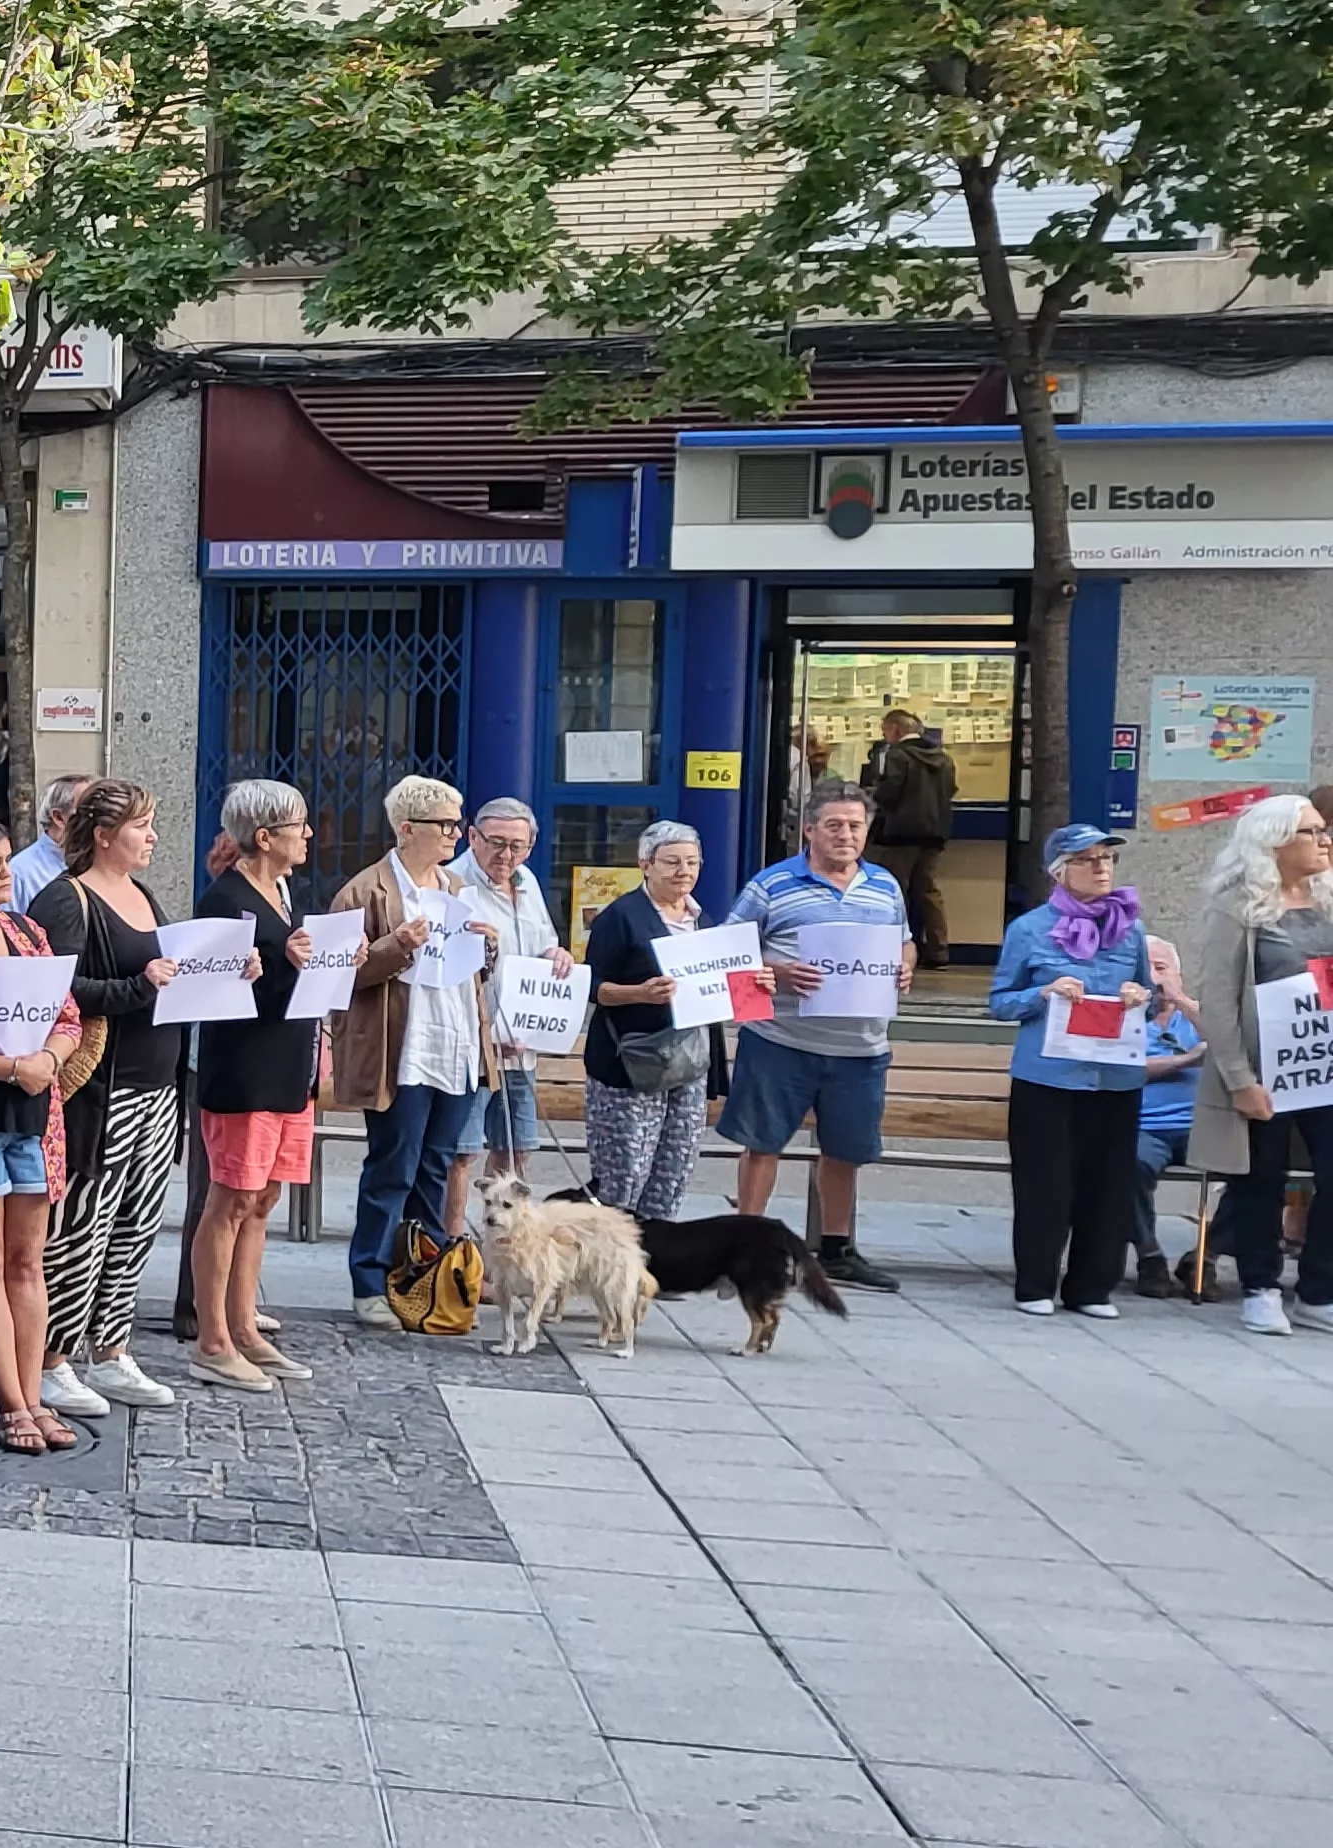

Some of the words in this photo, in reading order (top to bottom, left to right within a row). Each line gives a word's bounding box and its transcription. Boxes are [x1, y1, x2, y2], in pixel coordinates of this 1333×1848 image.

[901, 452, 1024, 478] Loterías
[899, 486, 1033, 518] Apuestas
[1063, 484, 1097, 510] el
[1109, 483, 1215, 509] Estado
[223, 544, 336, 567] LOTERIA
[361, 543, 377, 566] Y
[402, 542, 549, 566] PRIMITIVA
[1072, 548, 1105, 560] onso
[1183, 544, 1304, 559] Administración
[697, 768, 732, 782] 106
[686, 954, 753, 976] MACHISMO
[520, 978, 536, 996] NI
[541, 981, 572, 1000] UNA
[512, 1012, 568, 1033] MENOS
[1291, 1015, 1329, 1038] UN
